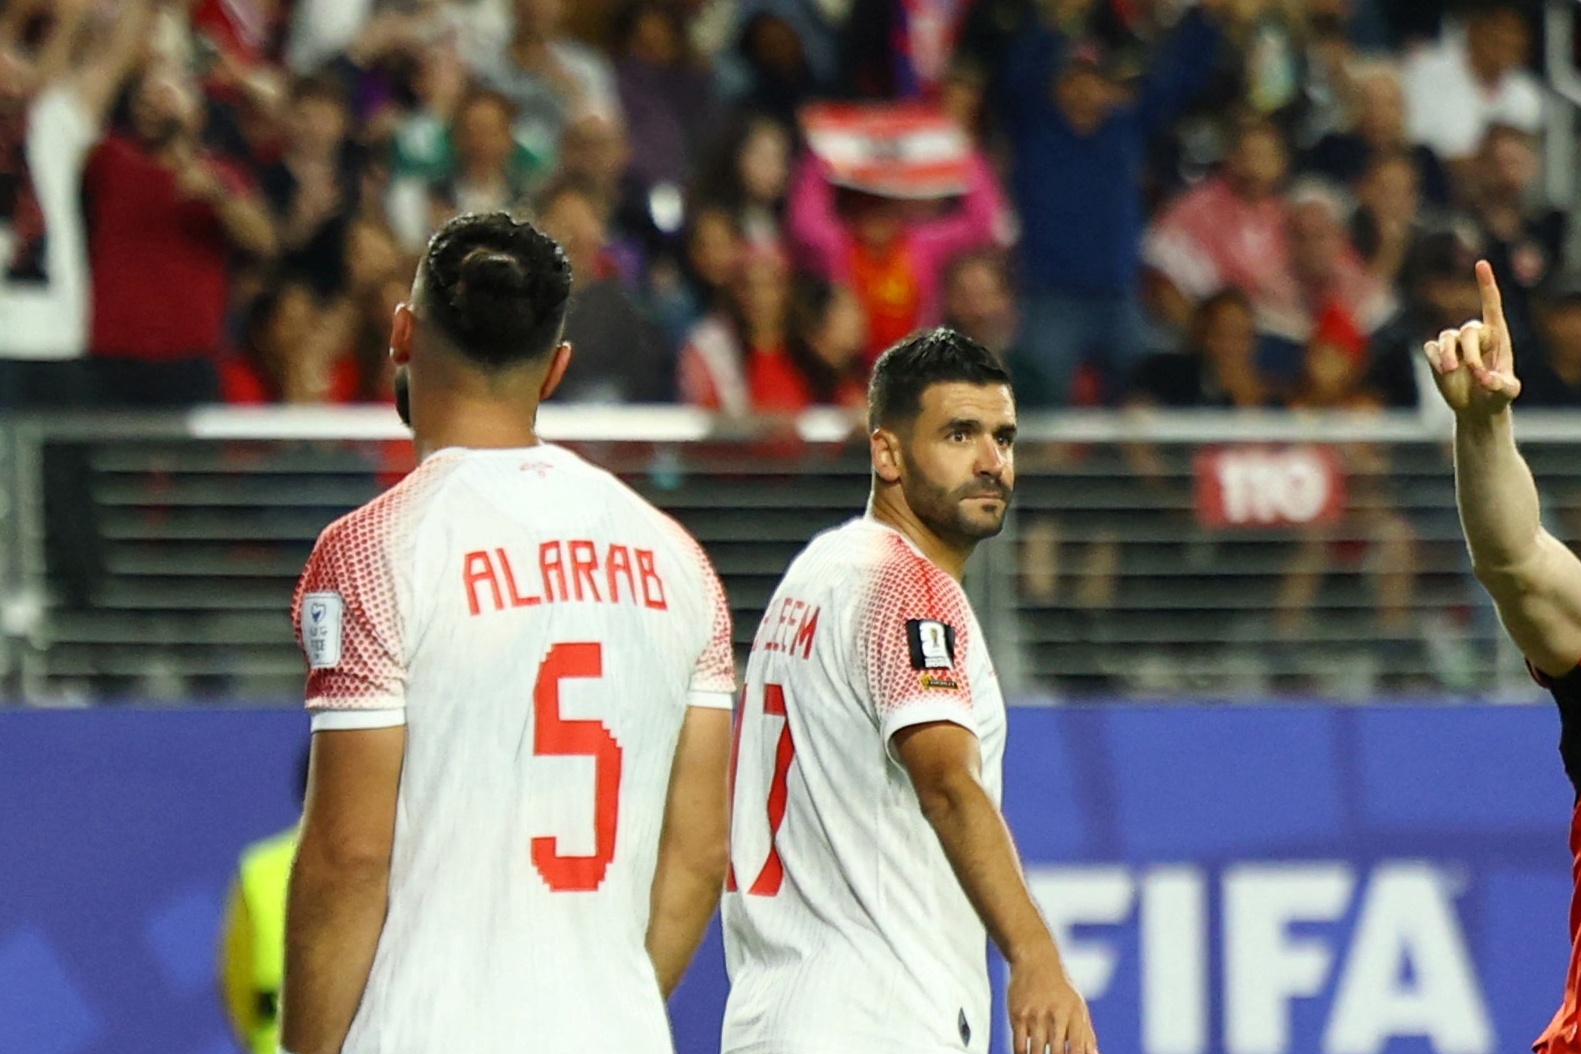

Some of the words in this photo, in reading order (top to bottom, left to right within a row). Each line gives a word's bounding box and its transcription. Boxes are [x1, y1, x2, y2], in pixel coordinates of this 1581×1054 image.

[1217, 451, 1328, 523] 110
[463, 540, 668, 616] ALARAB
[531, 642, 623, 892] 5
